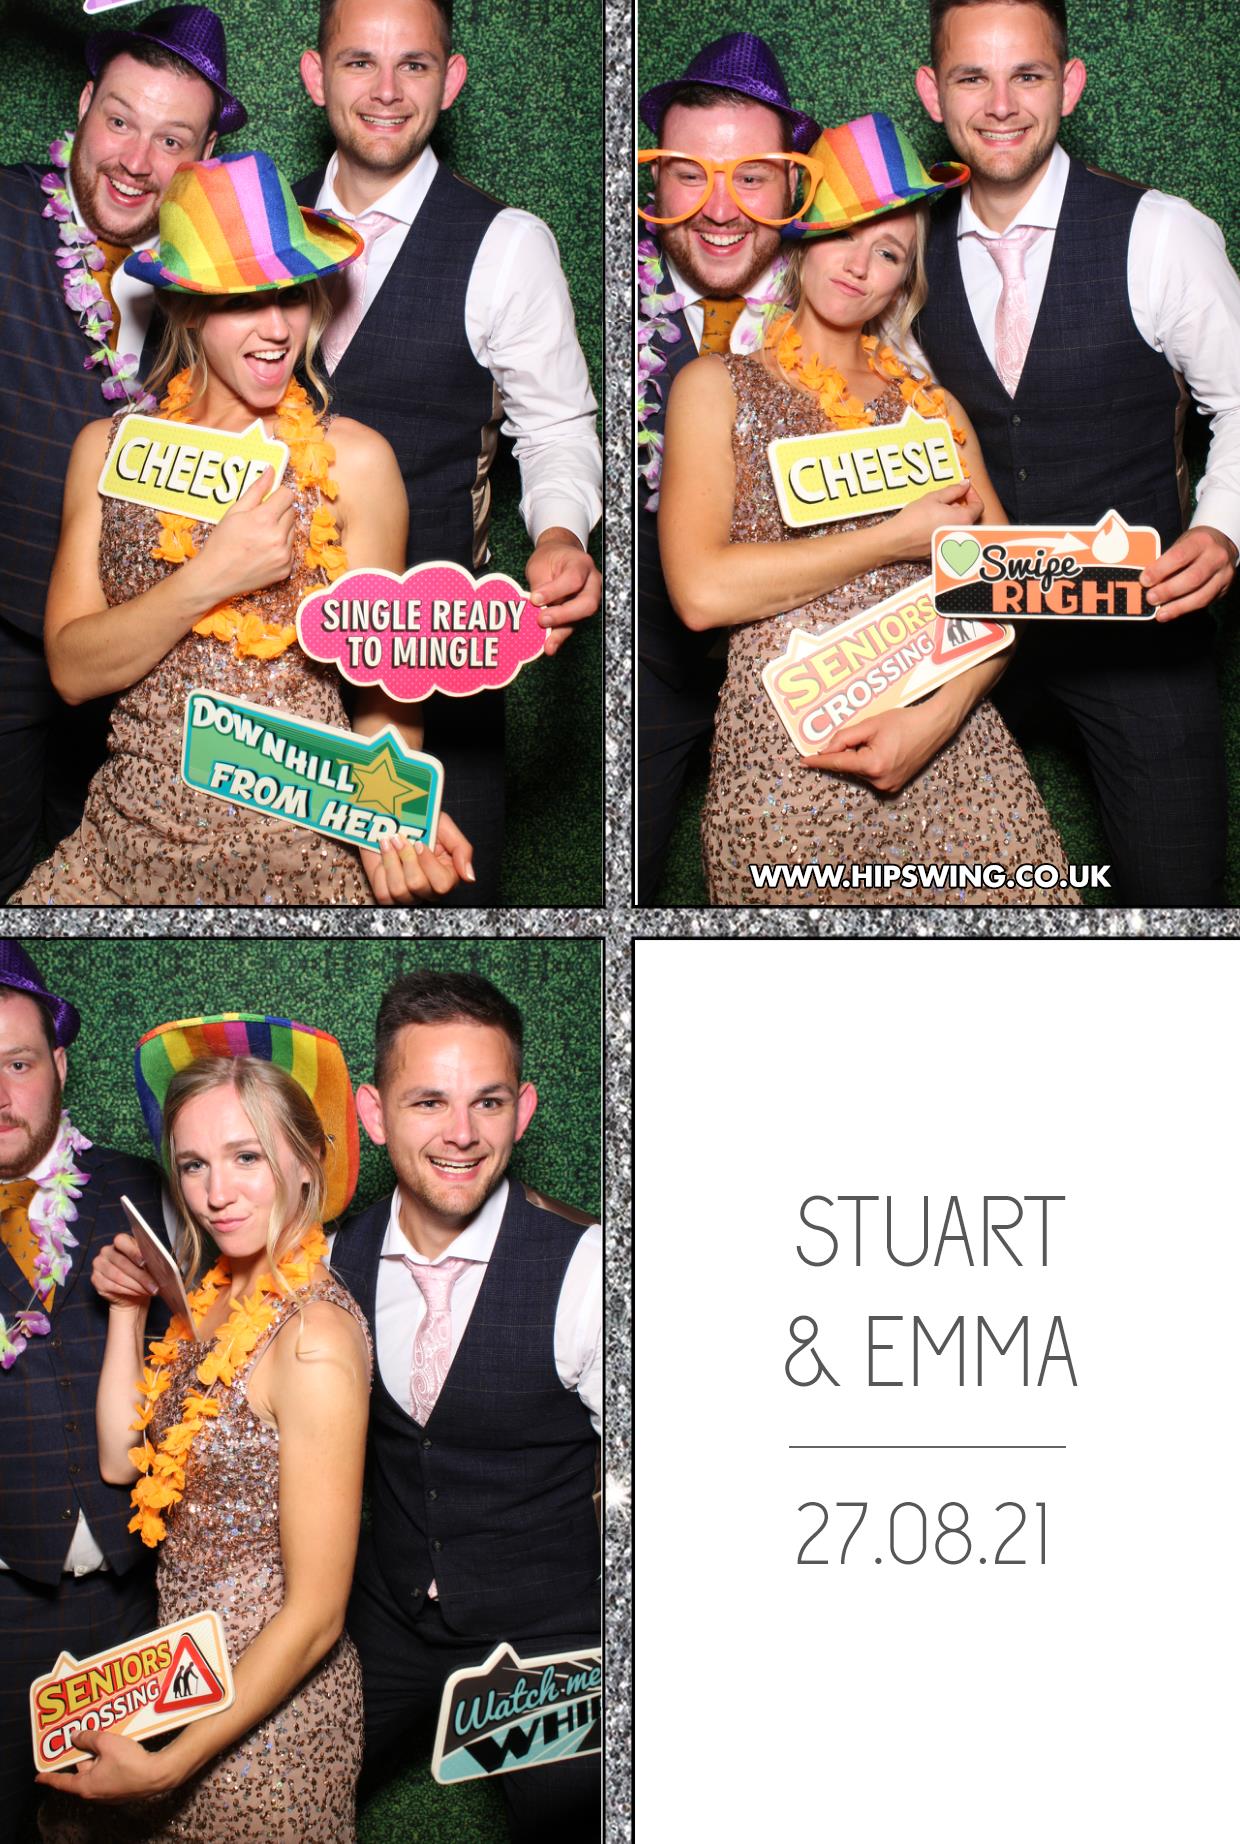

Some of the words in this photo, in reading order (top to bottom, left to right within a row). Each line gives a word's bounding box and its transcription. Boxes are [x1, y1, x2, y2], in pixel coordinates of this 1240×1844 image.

[788, 437, 954, 504] CHEESE
[979, 544, 1081, 592] Swipe
[991, 579, 1142, 615] RIGHT
[322, 599, 421, 632] SINGLE
[432, 599, 527, 632] READY
[346, 636, 382, 668] TO
[392, 636, 499, 668] MINGLE
[777, 596, 938, 710] SENIORS
[801, 633, 935, 743] CROSSING
[191, 697, 356, 794] DOWNHILL
[209, 762, 309, 819] FROM
[36, 1641, 172, 1729] SENIORS
[454, 1665, 558, 1736] Watch
[566, 1666, 601, 1696] me
